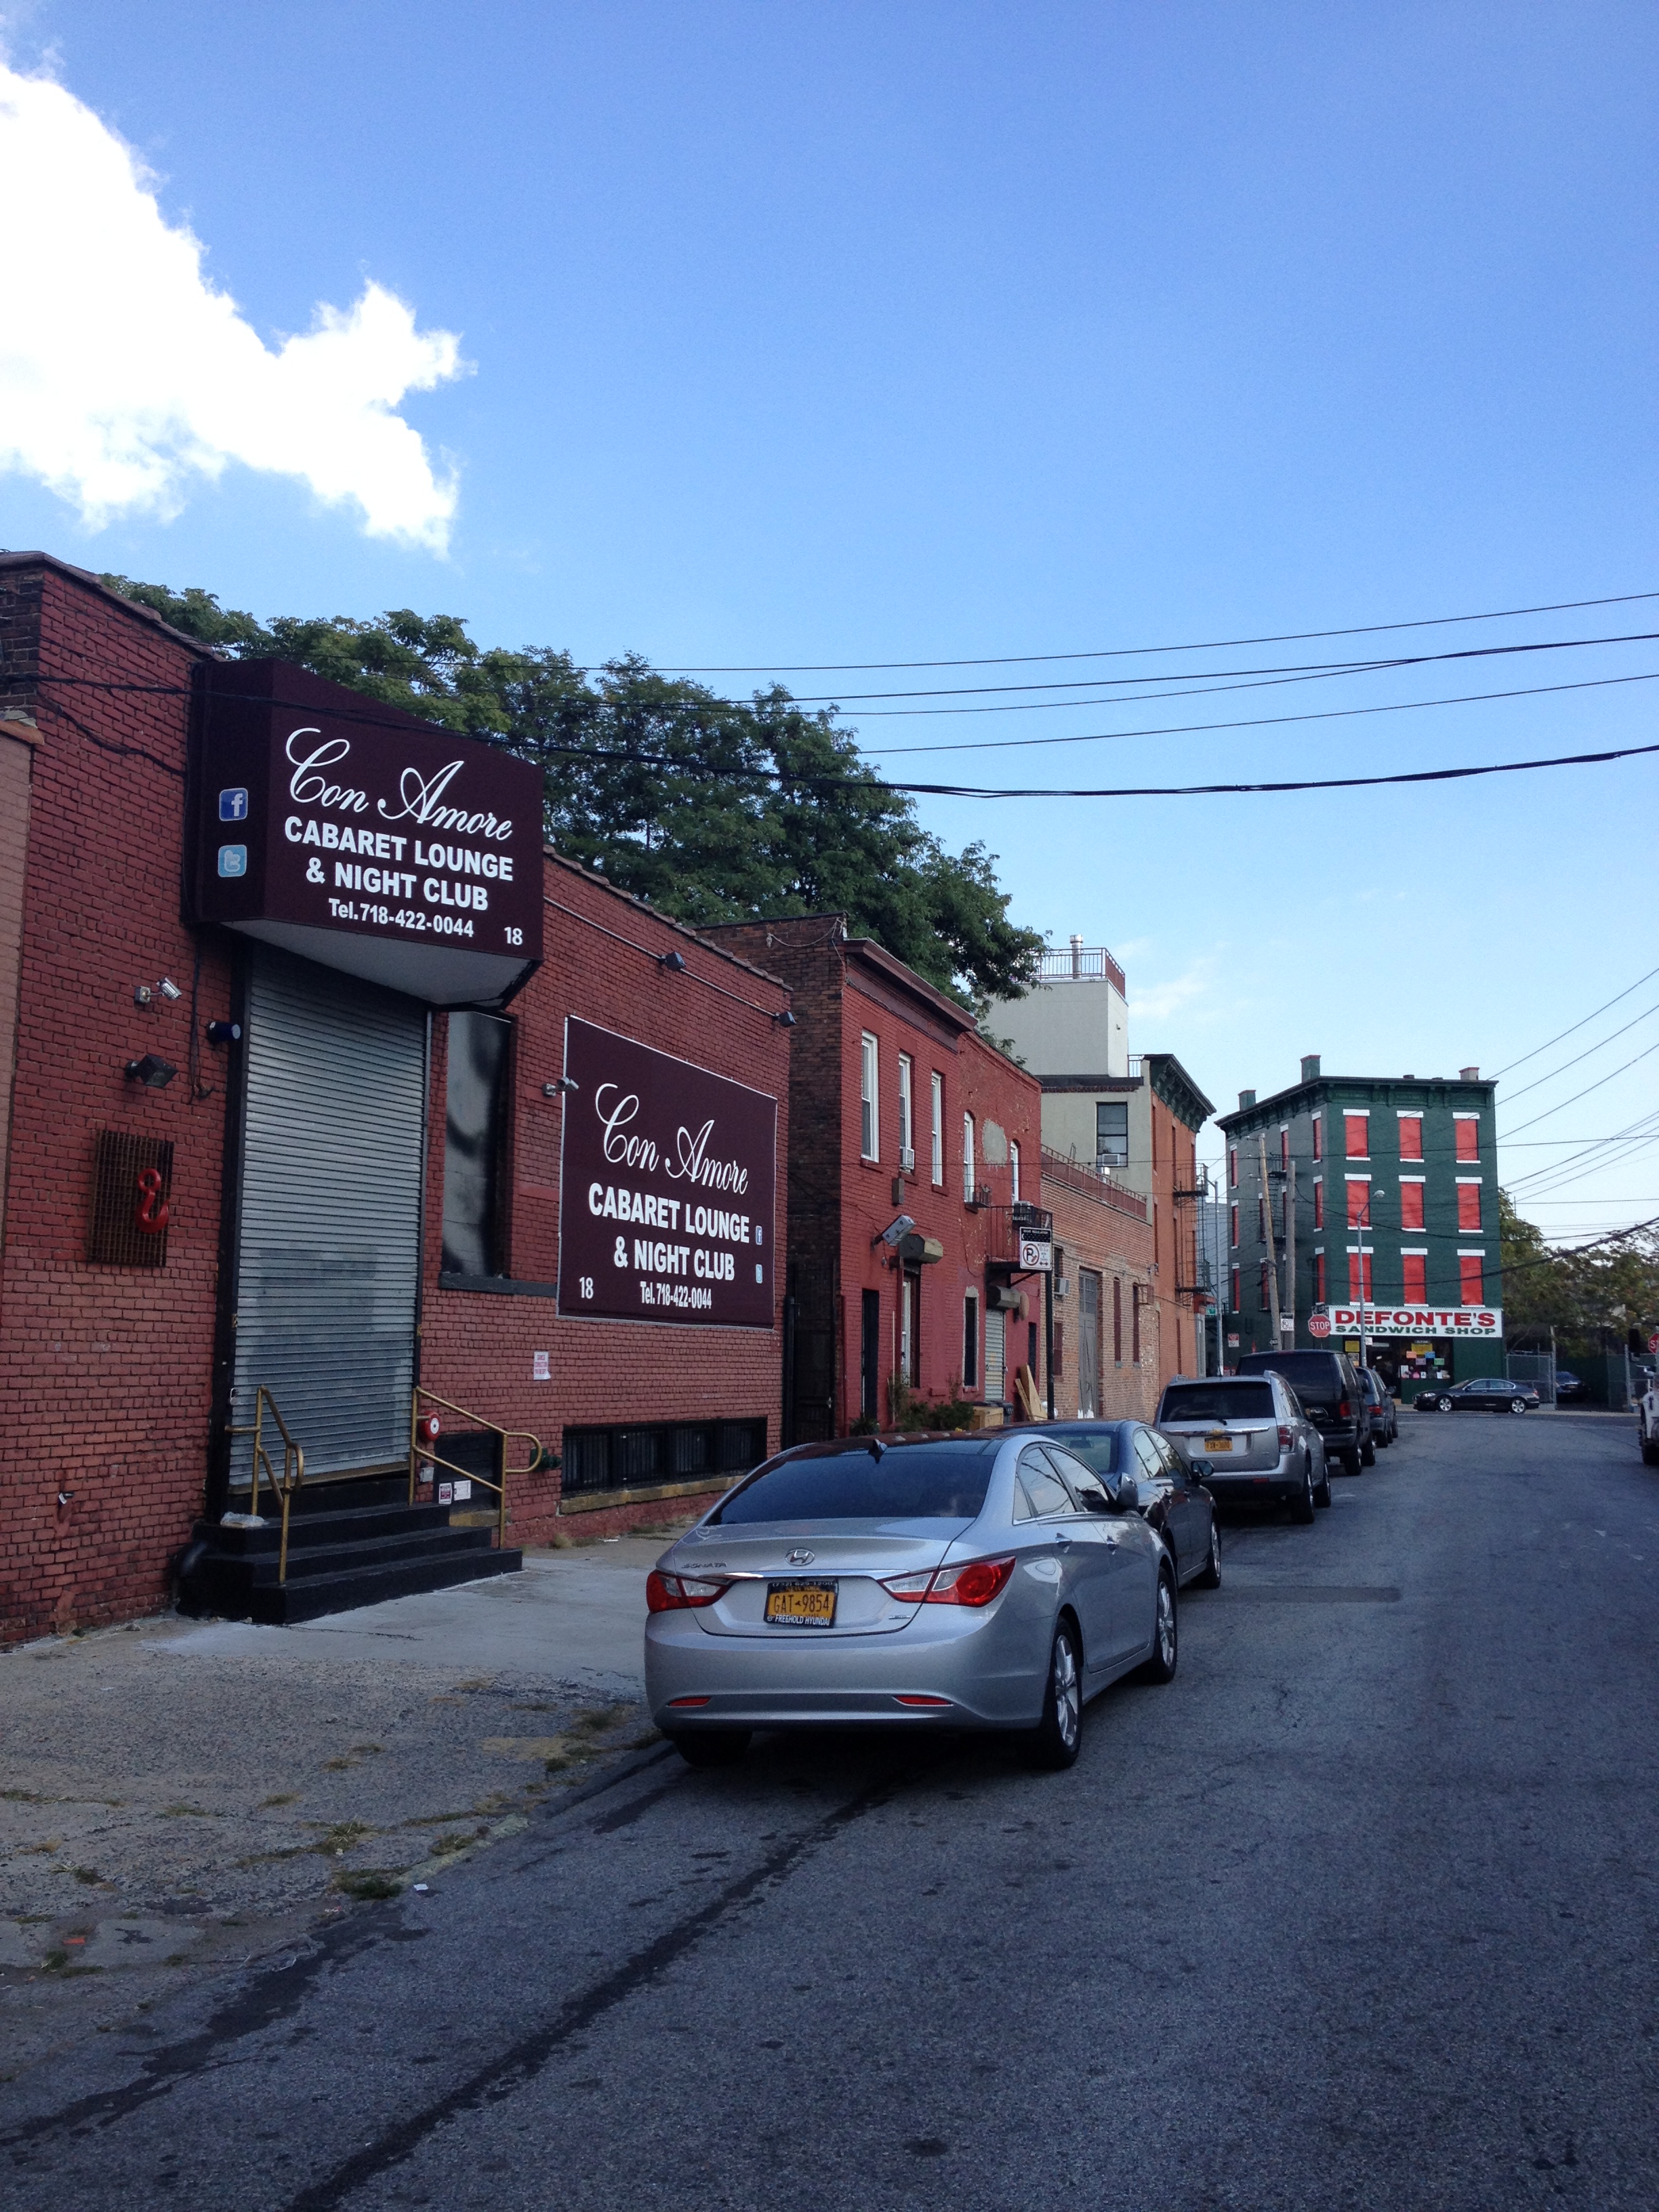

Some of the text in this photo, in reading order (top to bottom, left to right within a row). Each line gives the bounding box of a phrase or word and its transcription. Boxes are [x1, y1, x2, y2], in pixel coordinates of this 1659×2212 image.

[285, 728, 513, 841] Con Amore
[285, 816, 513, 882] CABARET LOUNGE
[306, 857, 489, 911] & NIGHT CLUB
[504, 926, 523, 945] 18
[595, 1083, 749, 1195] Con Amore
[588, 1182, 750, 1244] CABARET LOUNGE
[613, 1235, 735, 1281] & NIGHT CLUB
[579, 1276, 594, 1299] 18
[1310, 1322, 1330, 1330] STOP
[1334, 1310, 1496, 1327] DEFONTE'S
[1335, 1326, 1496, 1335] SANDWICH SHOP
[775, 1614, 830, 1626] FREEHOLD HYUNDAI
